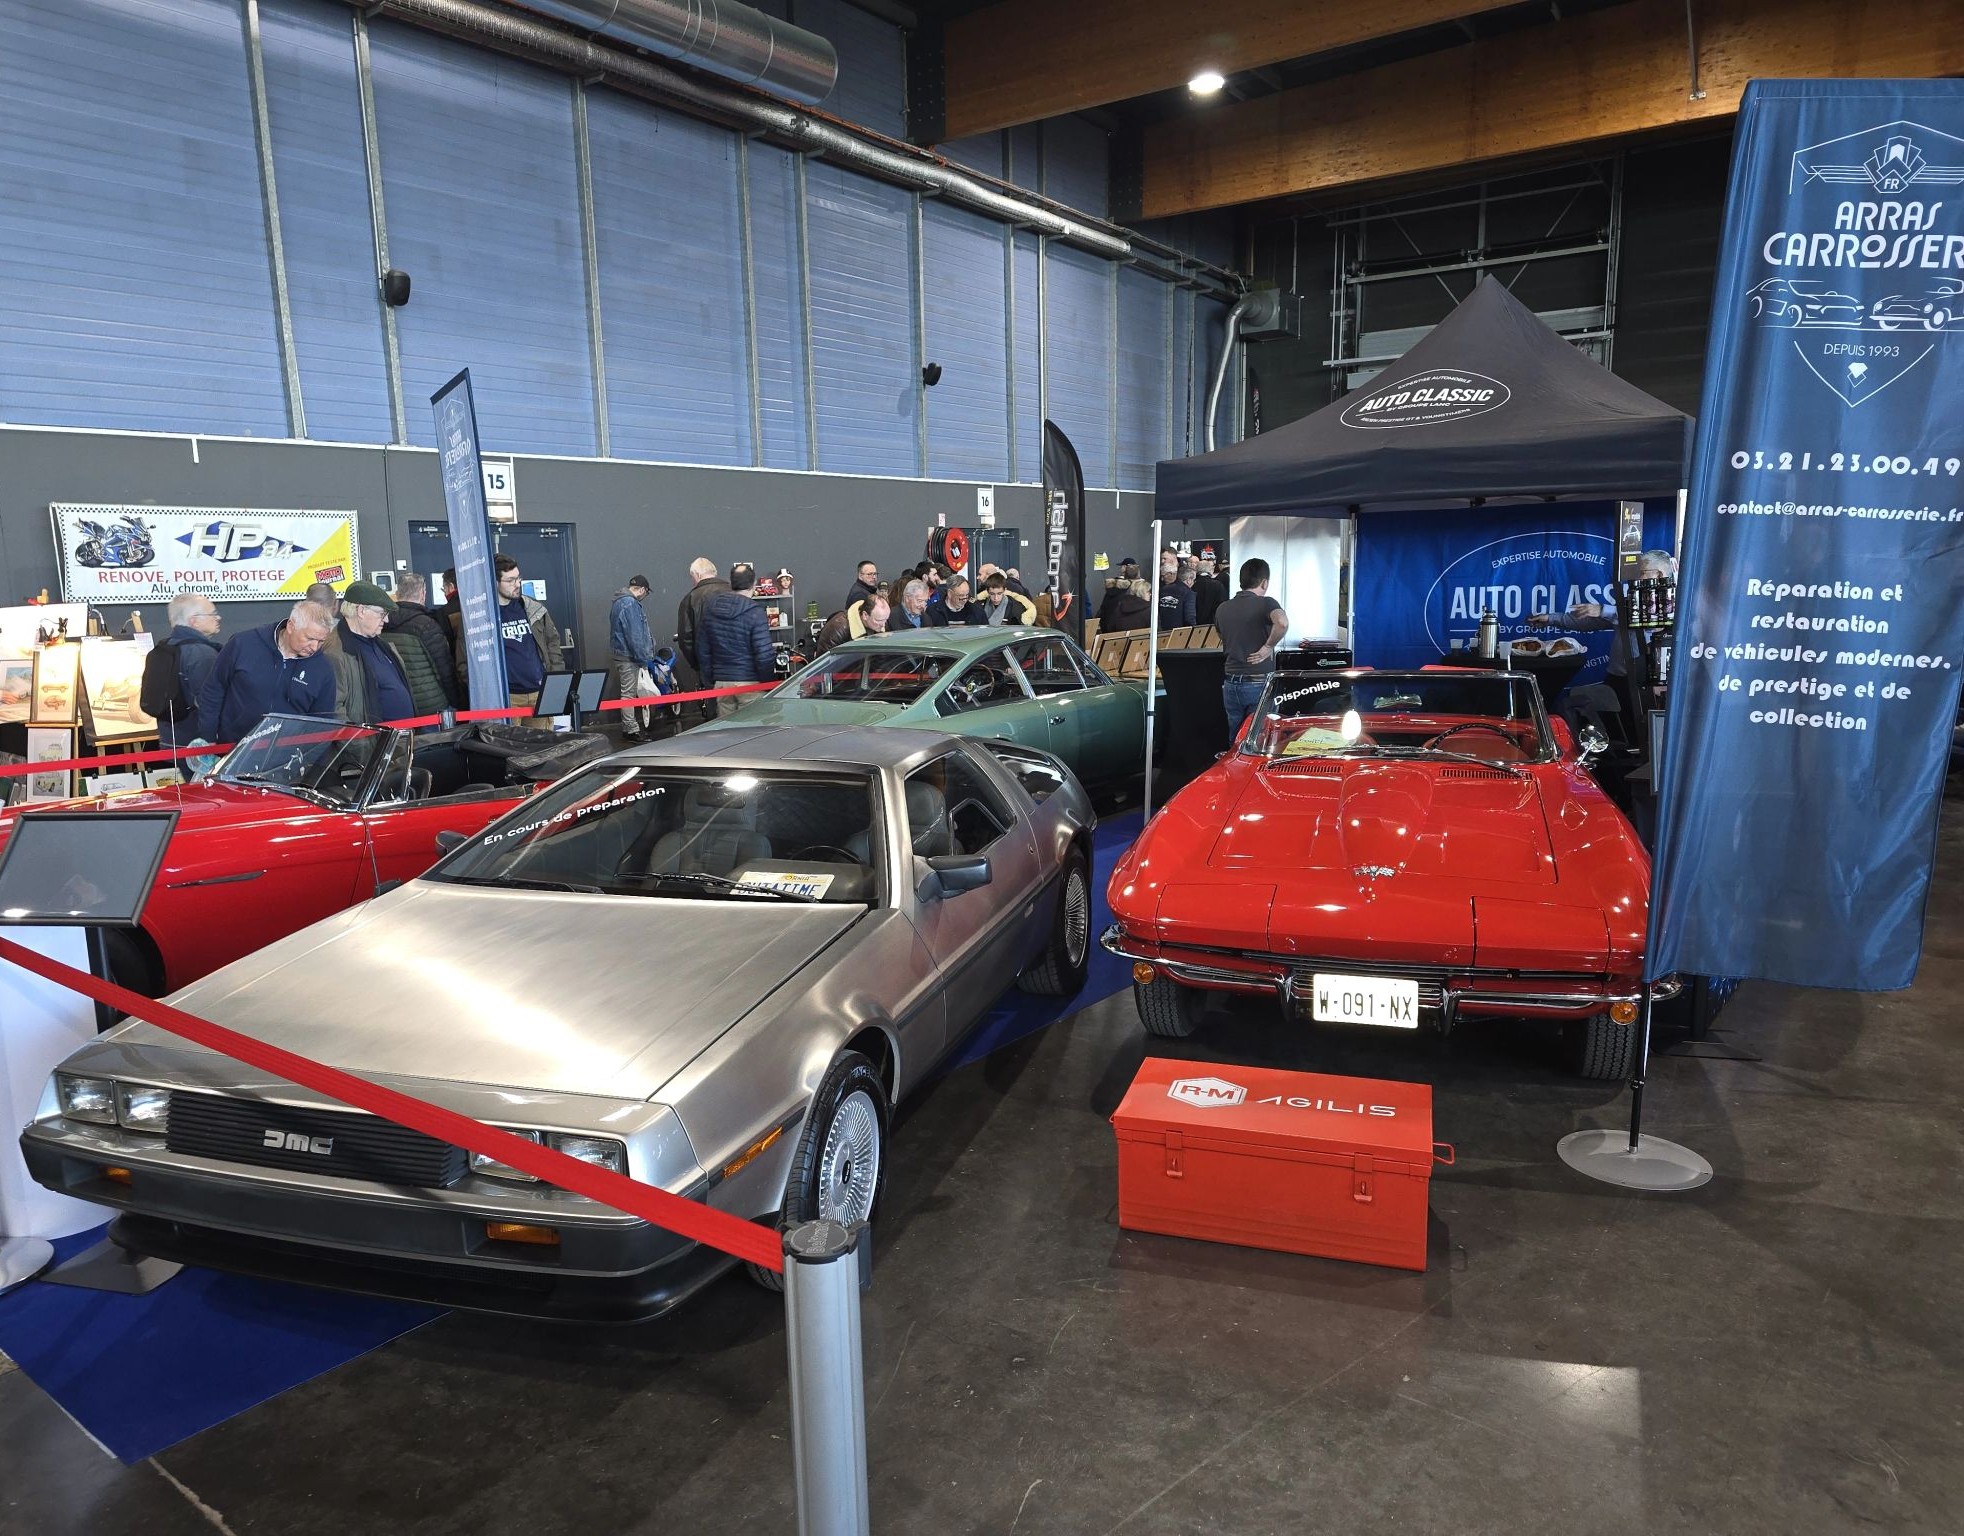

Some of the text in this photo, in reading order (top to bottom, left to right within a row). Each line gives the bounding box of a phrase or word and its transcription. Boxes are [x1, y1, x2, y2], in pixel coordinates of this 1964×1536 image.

[1884, 178, 1899, 190] FR
[1834, 201, 1943, 231] ARRAS
[1763, 232, 1964, 268] CARROSSER
[1823, 343, 1900, 357] DEPUIS 1993
[1359, 388, 1495, 412] AUTO CLASSIC
[1730, 451, 1961, 477] 03.21.23.00.49
[487, 473, 505, 490] 15
[981, 496, 990, 507] 16
[1717, 500, 1964, 522] contact@arras-carrosserie.fr
[1492, 551, 1541, 569] EXPERTISE
[1542, 550, 1607, 566] AUTOMOBILE
[99, 569, 285, 585] RENOVE, POLIT, PROTEGE
[151, 582, 259, 595] Alu, chrome, inox...
[1450, 583, 1629, 619] AUTO CLASS
[1746, 578, 1903, 602] Réparation et
[1499, 625, 1513, 634] BY
[1515, 625, 1561, 634] GROUPE
[1751, 612, 1889, 634] restauration
[1690, 643, 1718, 660] de
[1724, 642, 1828, 663] véhicules
[1273, 680, 1341, 706] Disponible
[1718, 675, 1912, 700] de prestige et de
[1749, 708, 1867, 731] collection
[483, 787, 666, 846] En cours de preparation
[1319, 990, 1412, 1021] W-091-NX
[1180, 1085, 1396, 1117] R-M AGILIS
[263, 1129, 334, 1155] DMC
